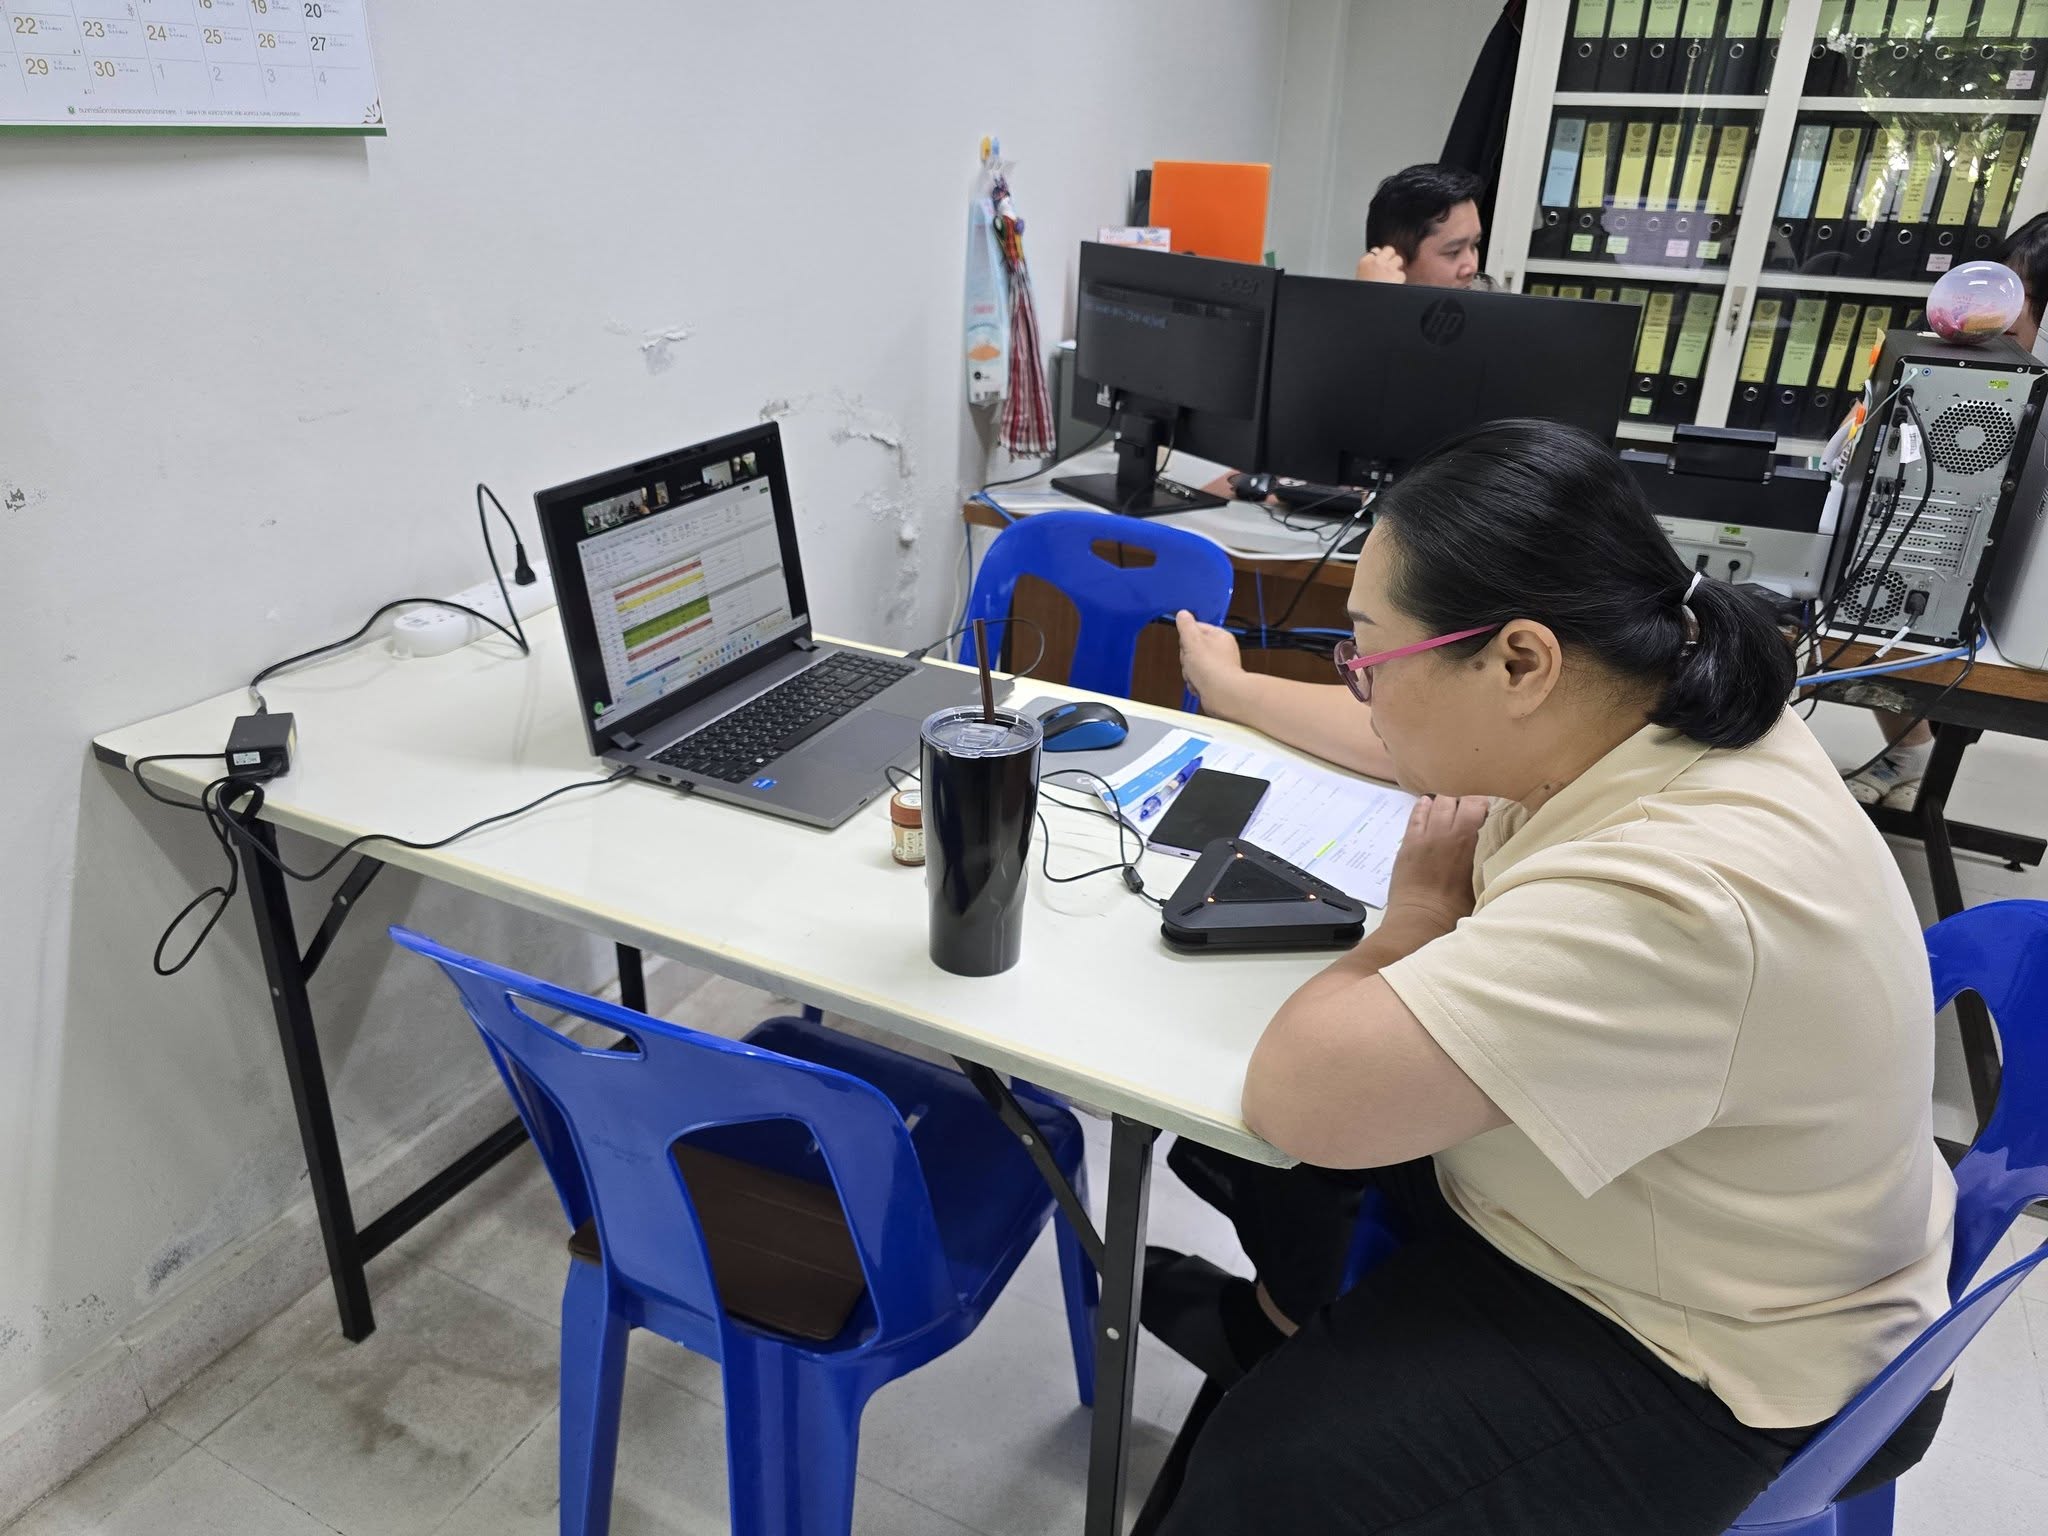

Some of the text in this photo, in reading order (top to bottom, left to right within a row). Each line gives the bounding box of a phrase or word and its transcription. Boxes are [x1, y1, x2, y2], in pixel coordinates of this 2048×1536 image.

[252, 0, 267, 14] 19
[304, 3, 322, 18] 20
[13, 16, 38, 35] 22
[82, 20, 105, 38] 23
[147, 25, 167, 41] 24
[203, 29, 222, 44] 25
[258, 33, 276, 48] 26
[310, 37, 326, 51] 27
[25, 58, 49, 75] 29
[93, 61, 116, 77] 30
[156, 64, 165, 80] 1
[213, 66, 223, 82] 2
[266, 69, 276, 83] 3
[319, 71, 328, 85] 4
[1424, 300, 1465, 344] hp
